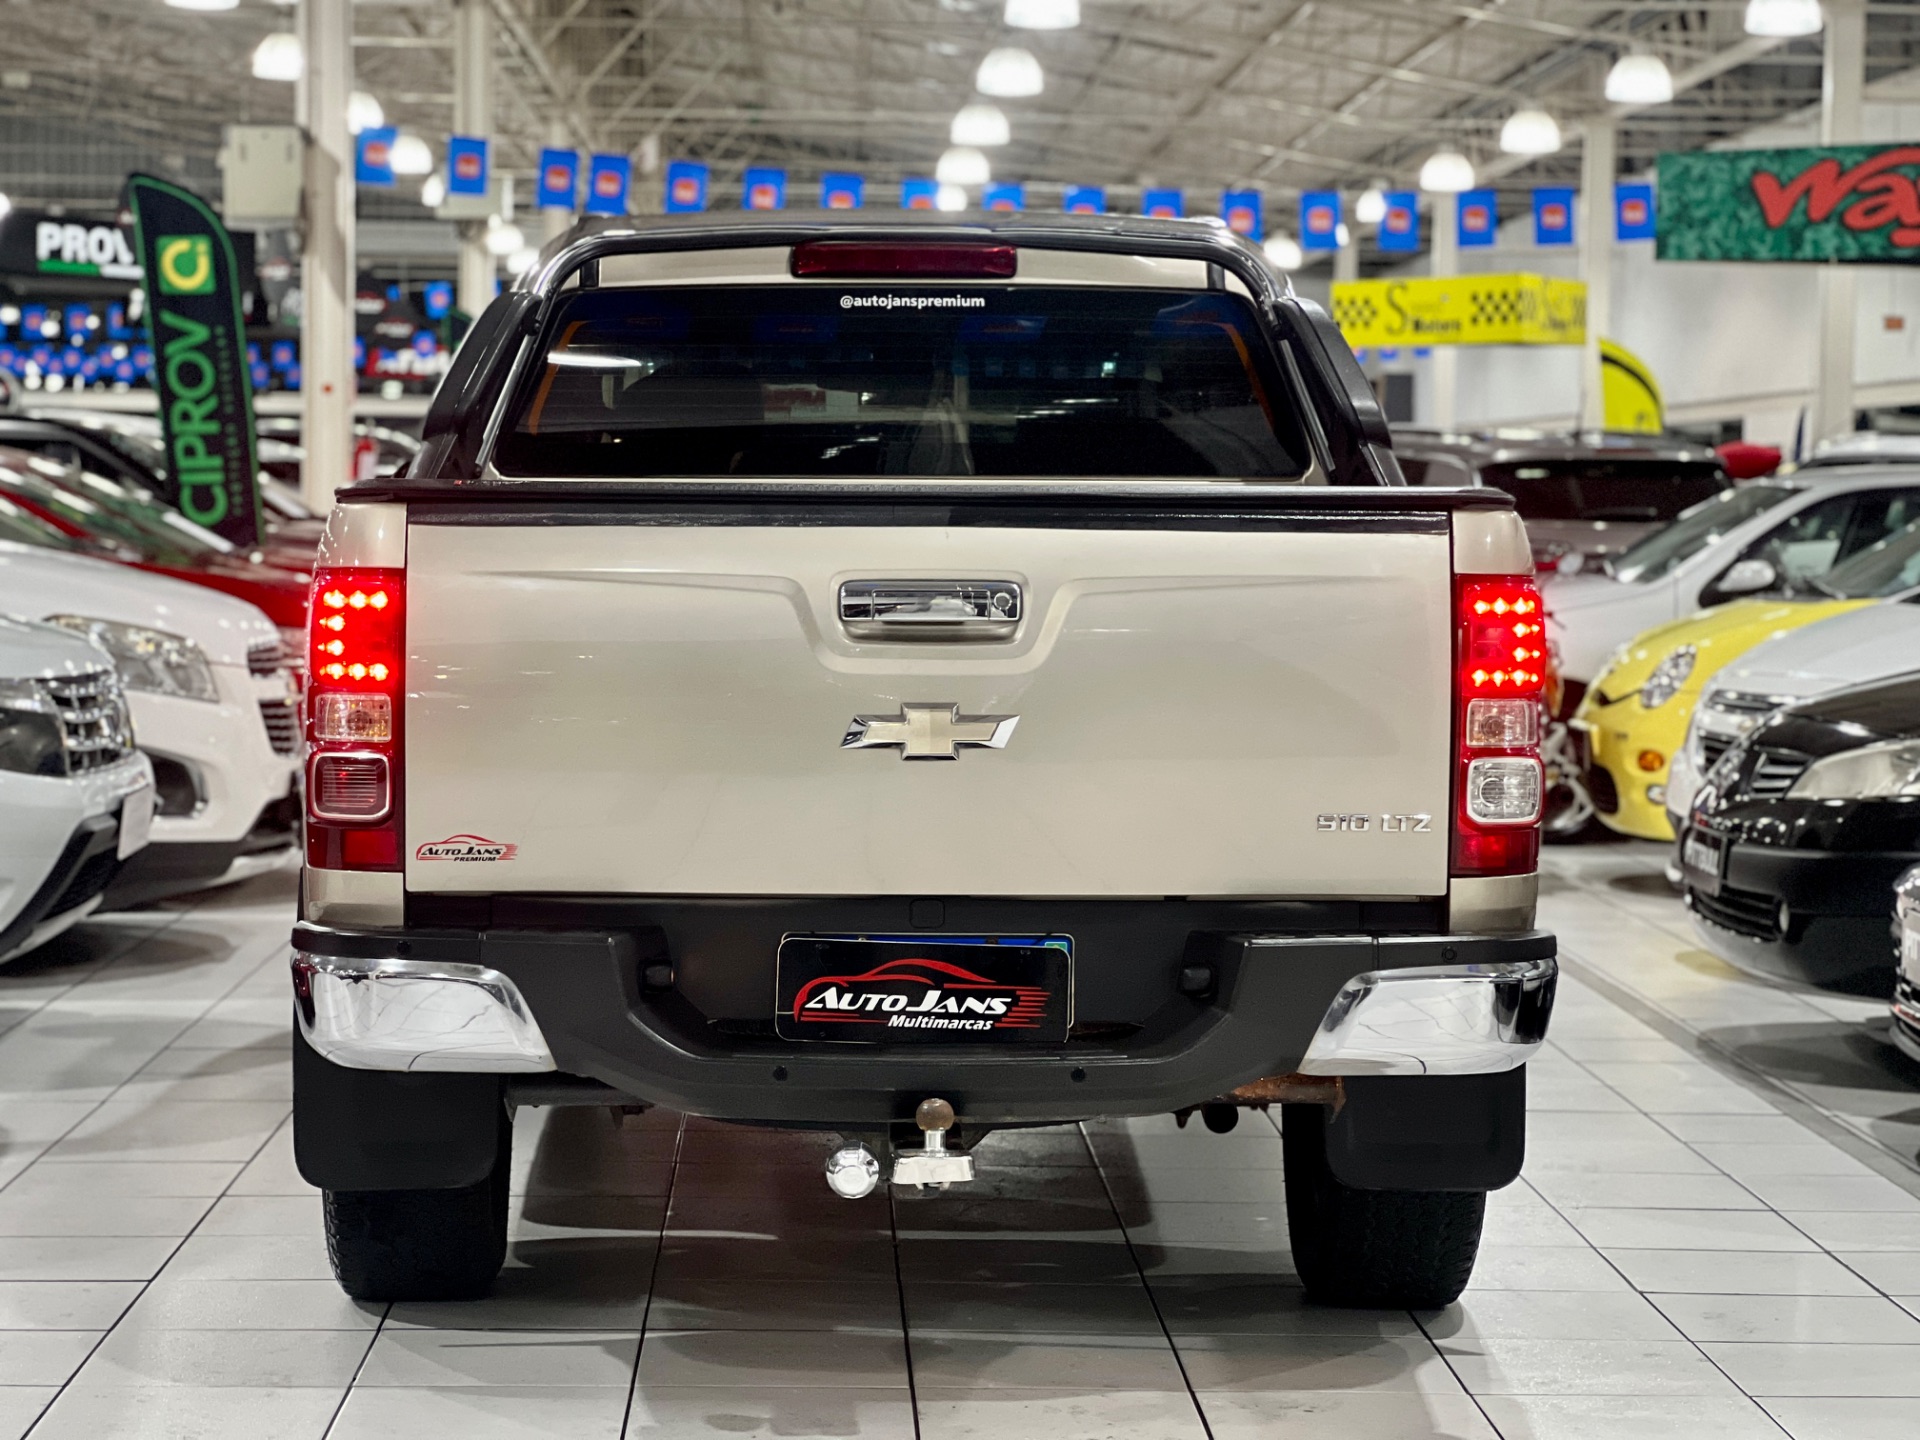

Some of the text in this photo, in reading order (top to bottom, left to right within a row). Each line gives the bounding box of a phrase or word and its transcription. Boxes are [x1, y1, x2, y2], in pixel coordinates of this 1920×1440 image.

[840, 294, 985, 309] @autojanspremium
[159, 309, 229, 526] CIPROV
[1317, 813, 1432, 832] S10 LTZ
[887, 1014, 993, 1031] Multimarcas
